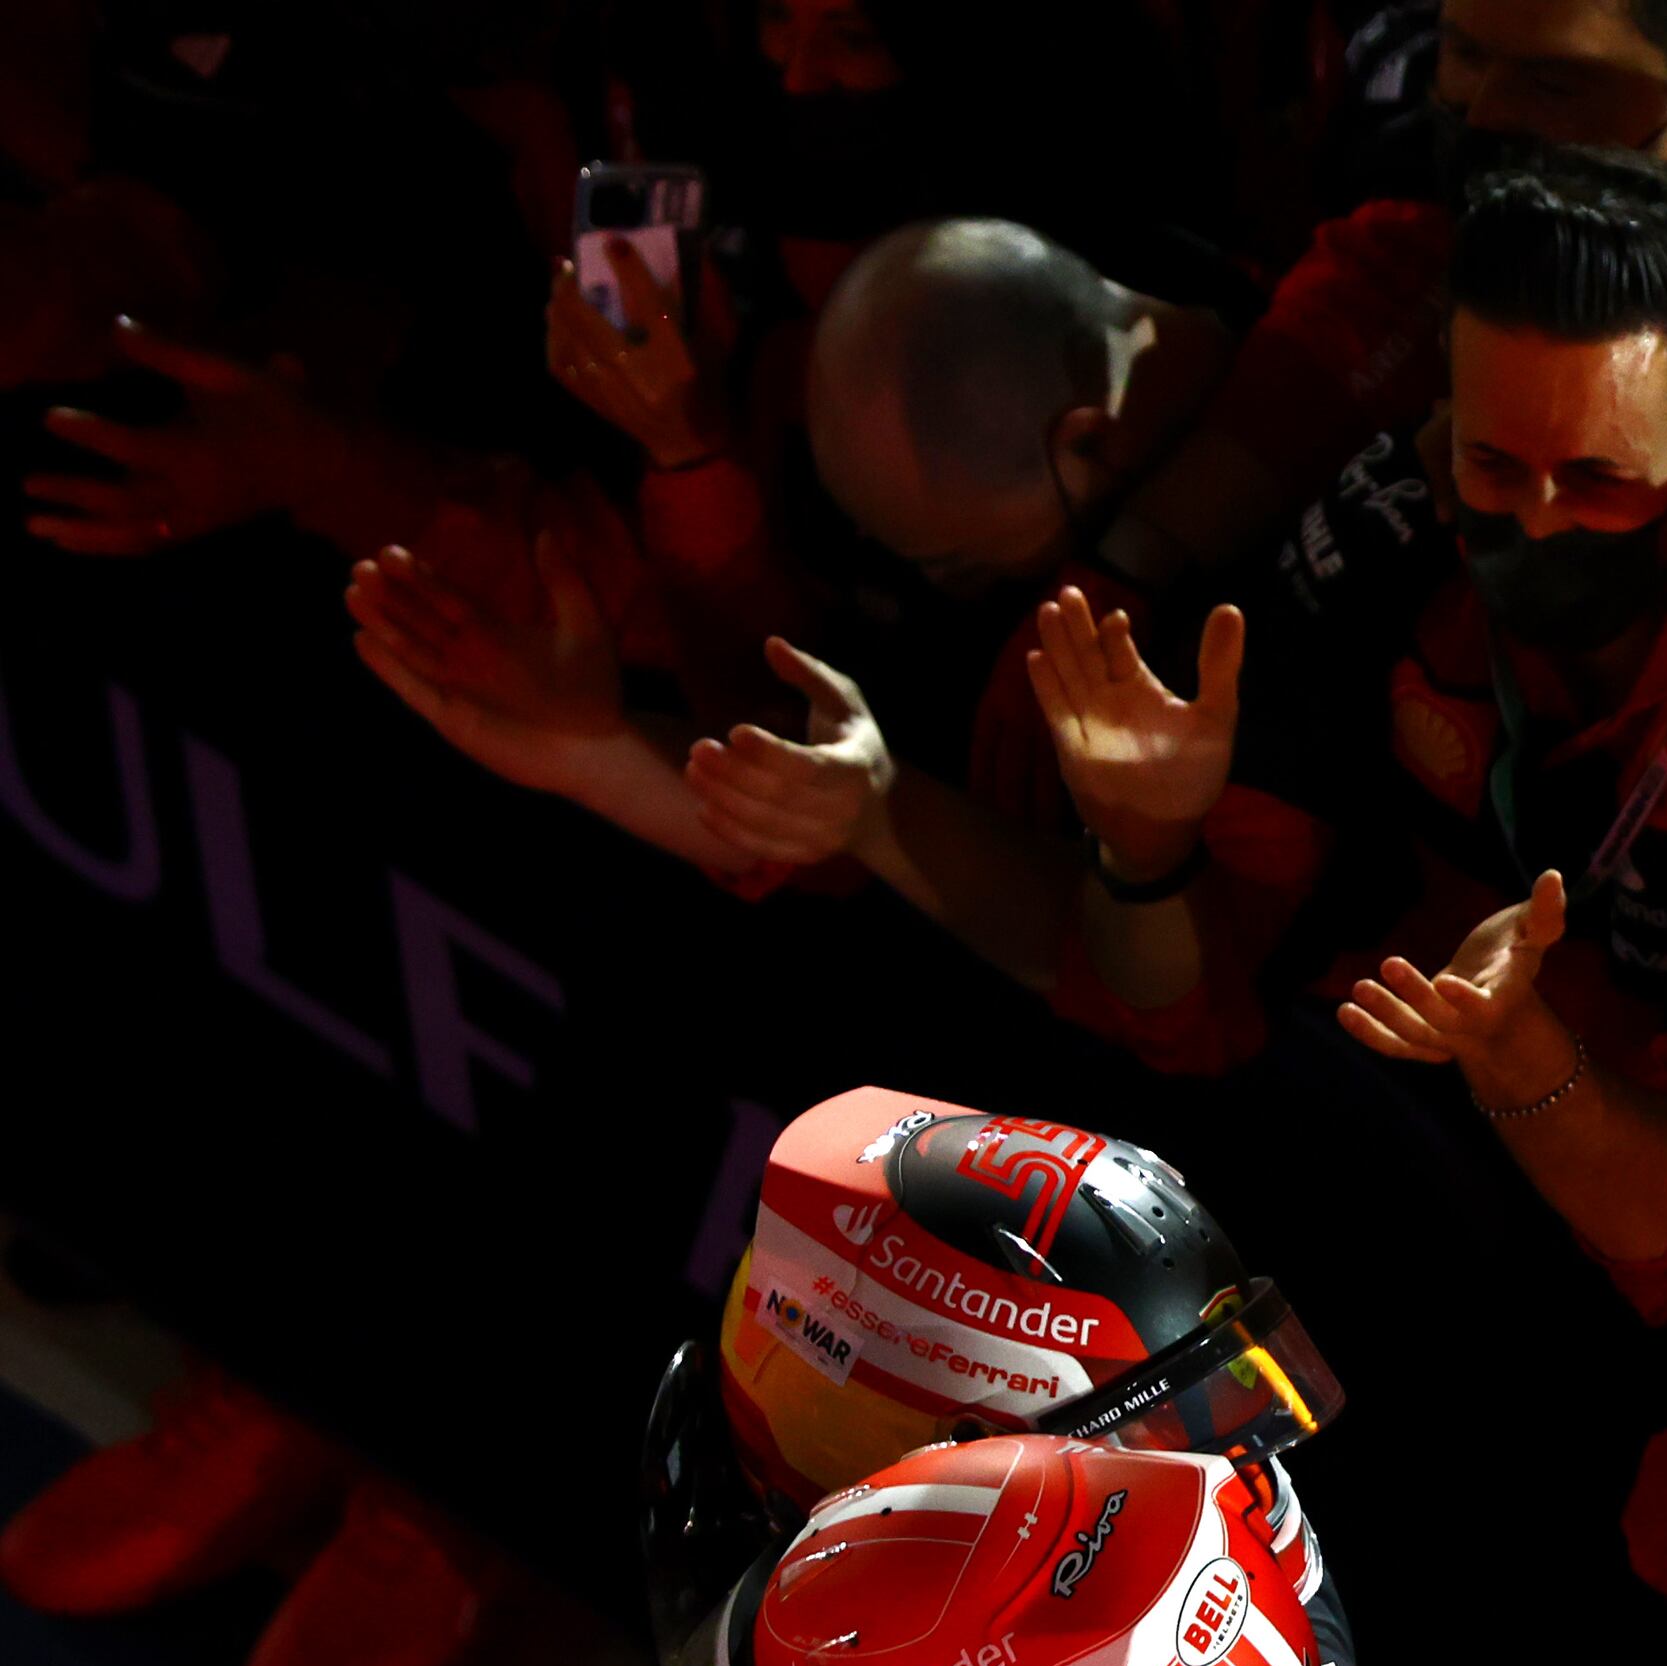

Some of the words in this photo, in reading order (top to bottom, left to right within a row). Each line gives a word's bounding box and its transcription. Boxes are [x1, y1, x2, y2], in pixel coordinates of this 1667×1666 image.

[869, 1234, 1100, 1348] Santander
[802, 1313, 853, 1366] WAR
[812, 1275, 1060, 1399] #essereFerrari
[1123, 1377, 1171, 1412] MILLE
[1183, 1573, 1239, 1655] BELL
